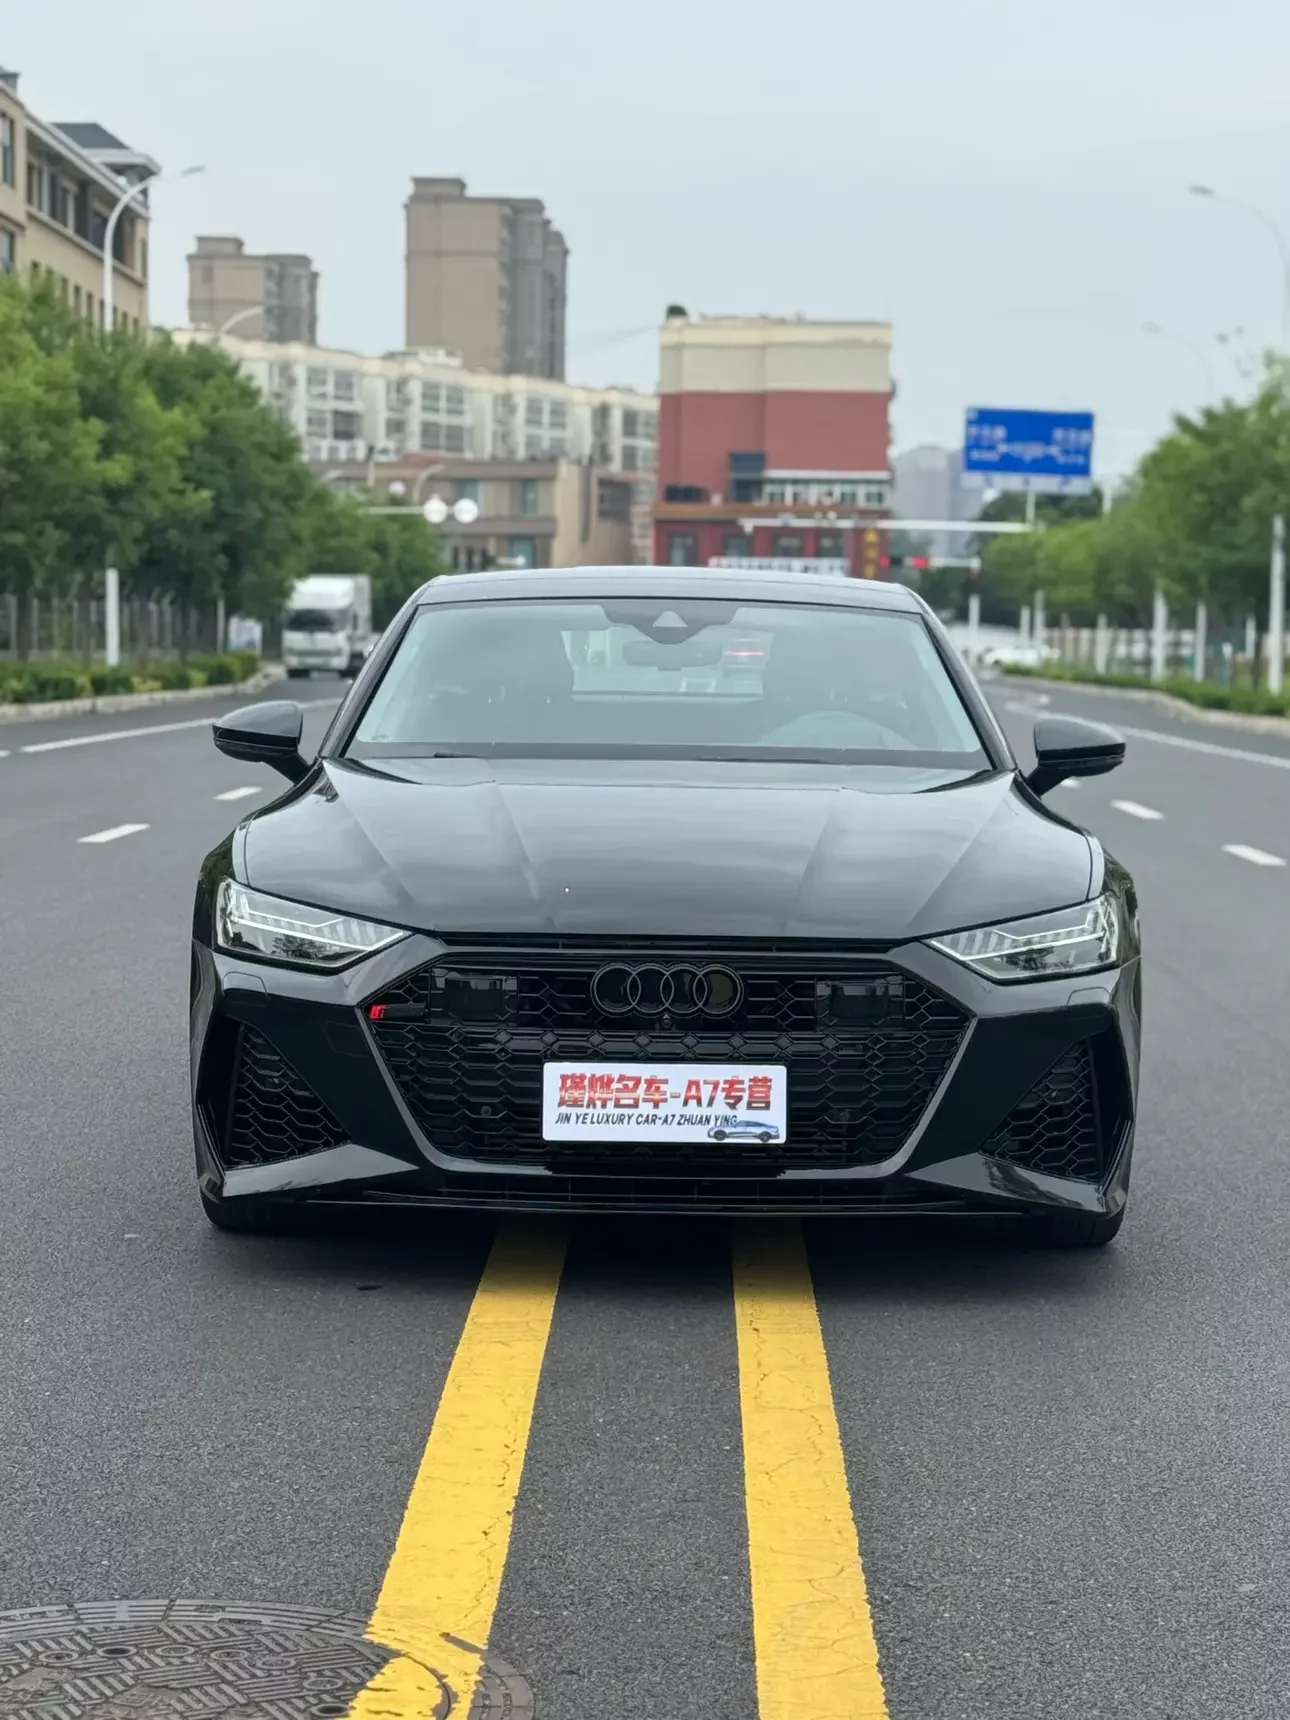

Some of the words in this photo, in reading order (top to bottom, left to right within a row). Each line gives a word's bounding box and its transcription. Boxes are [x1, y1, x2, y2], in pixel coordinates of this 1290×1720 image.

[558, 1073, 773, 1111] 瑾烨名车-A7专营
[555, 1112, 571, 1125] JIN
[575, 1112, 589, 1125] YE
[590, 1112, 634, 1125] LUXURY
[635, 1113, 676, 1126] CAR-A7
[677, 1114, 711, 1126] ZHUAN
[714, 1114, 738, 1127] YING
